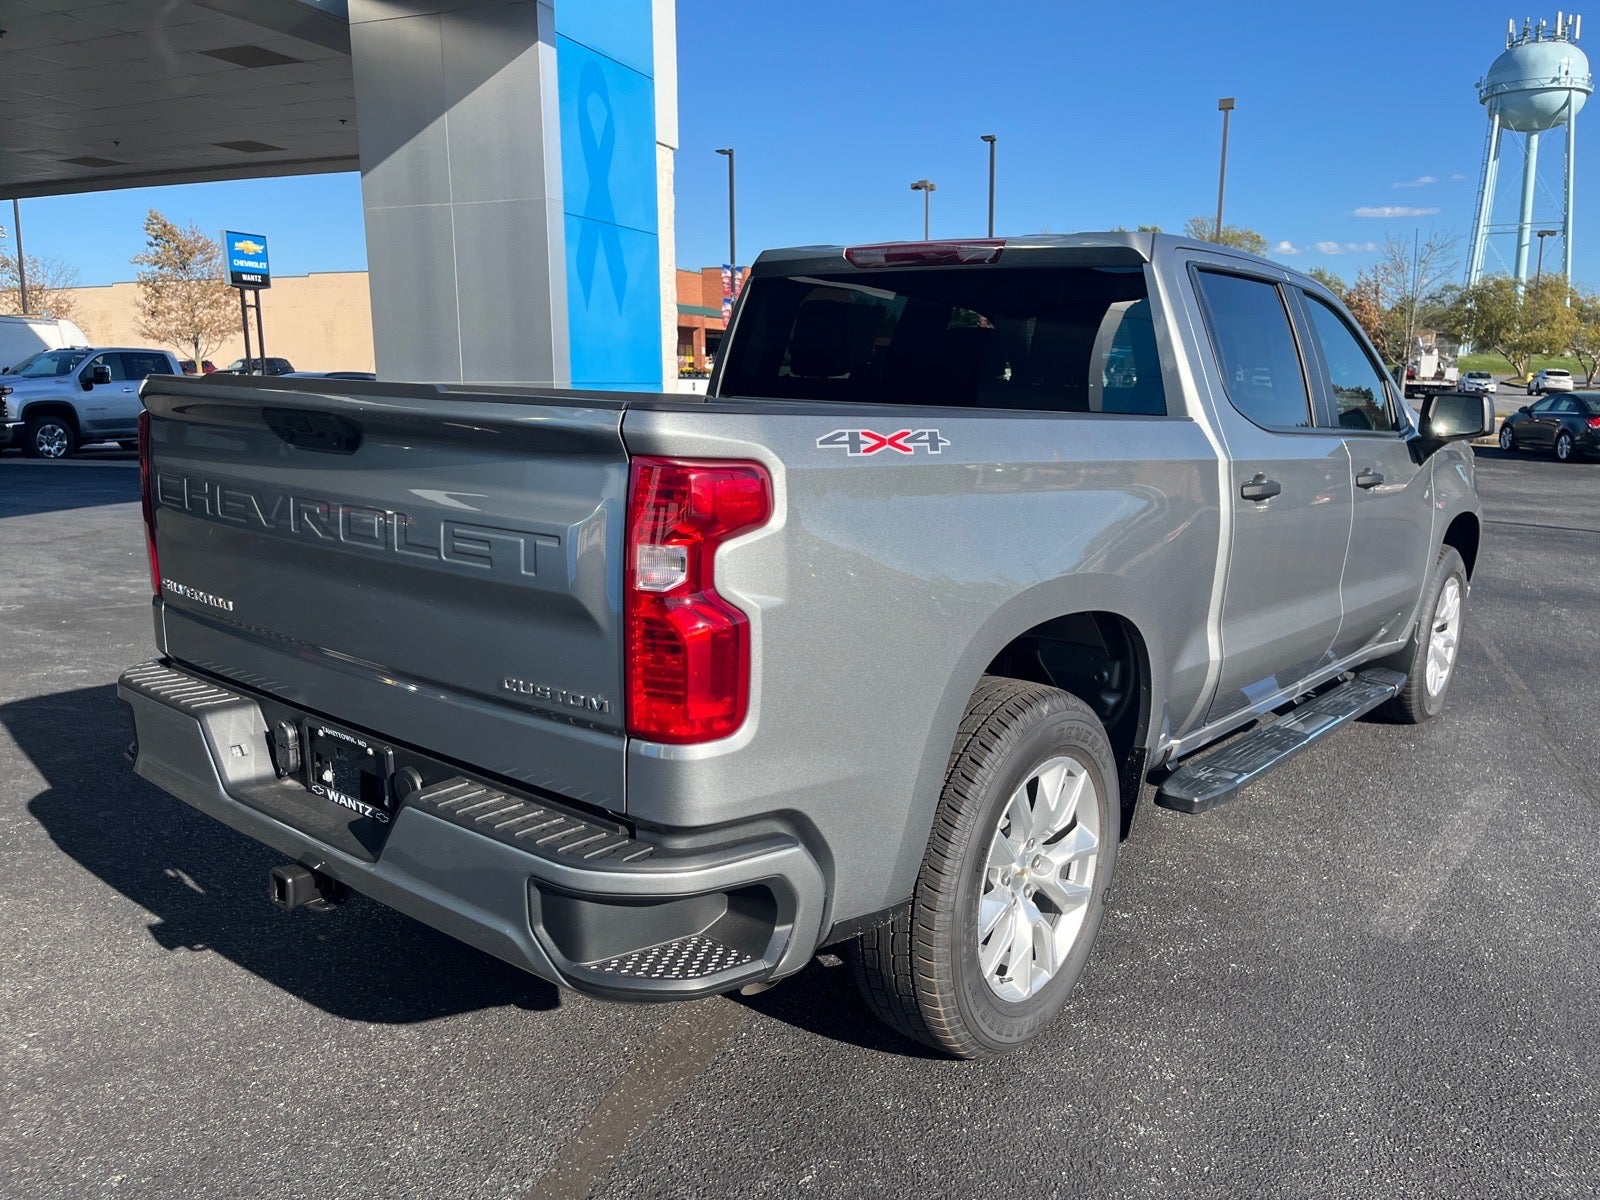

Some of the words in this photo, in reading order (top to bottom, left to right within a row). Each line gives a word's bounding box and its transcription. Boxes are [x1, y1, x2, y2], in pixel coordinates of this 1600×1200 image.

[233, 259, 267, 269] CHEVROLET
[242, 273, 262, 282] WANTZ
[157, 472, 561, 577] CHEVROLET
[162, 578, 234, 611] SILVERADO
[503, 677, 610, 713] CUSTOM
[326, 788, 373, 818] WANTZ
